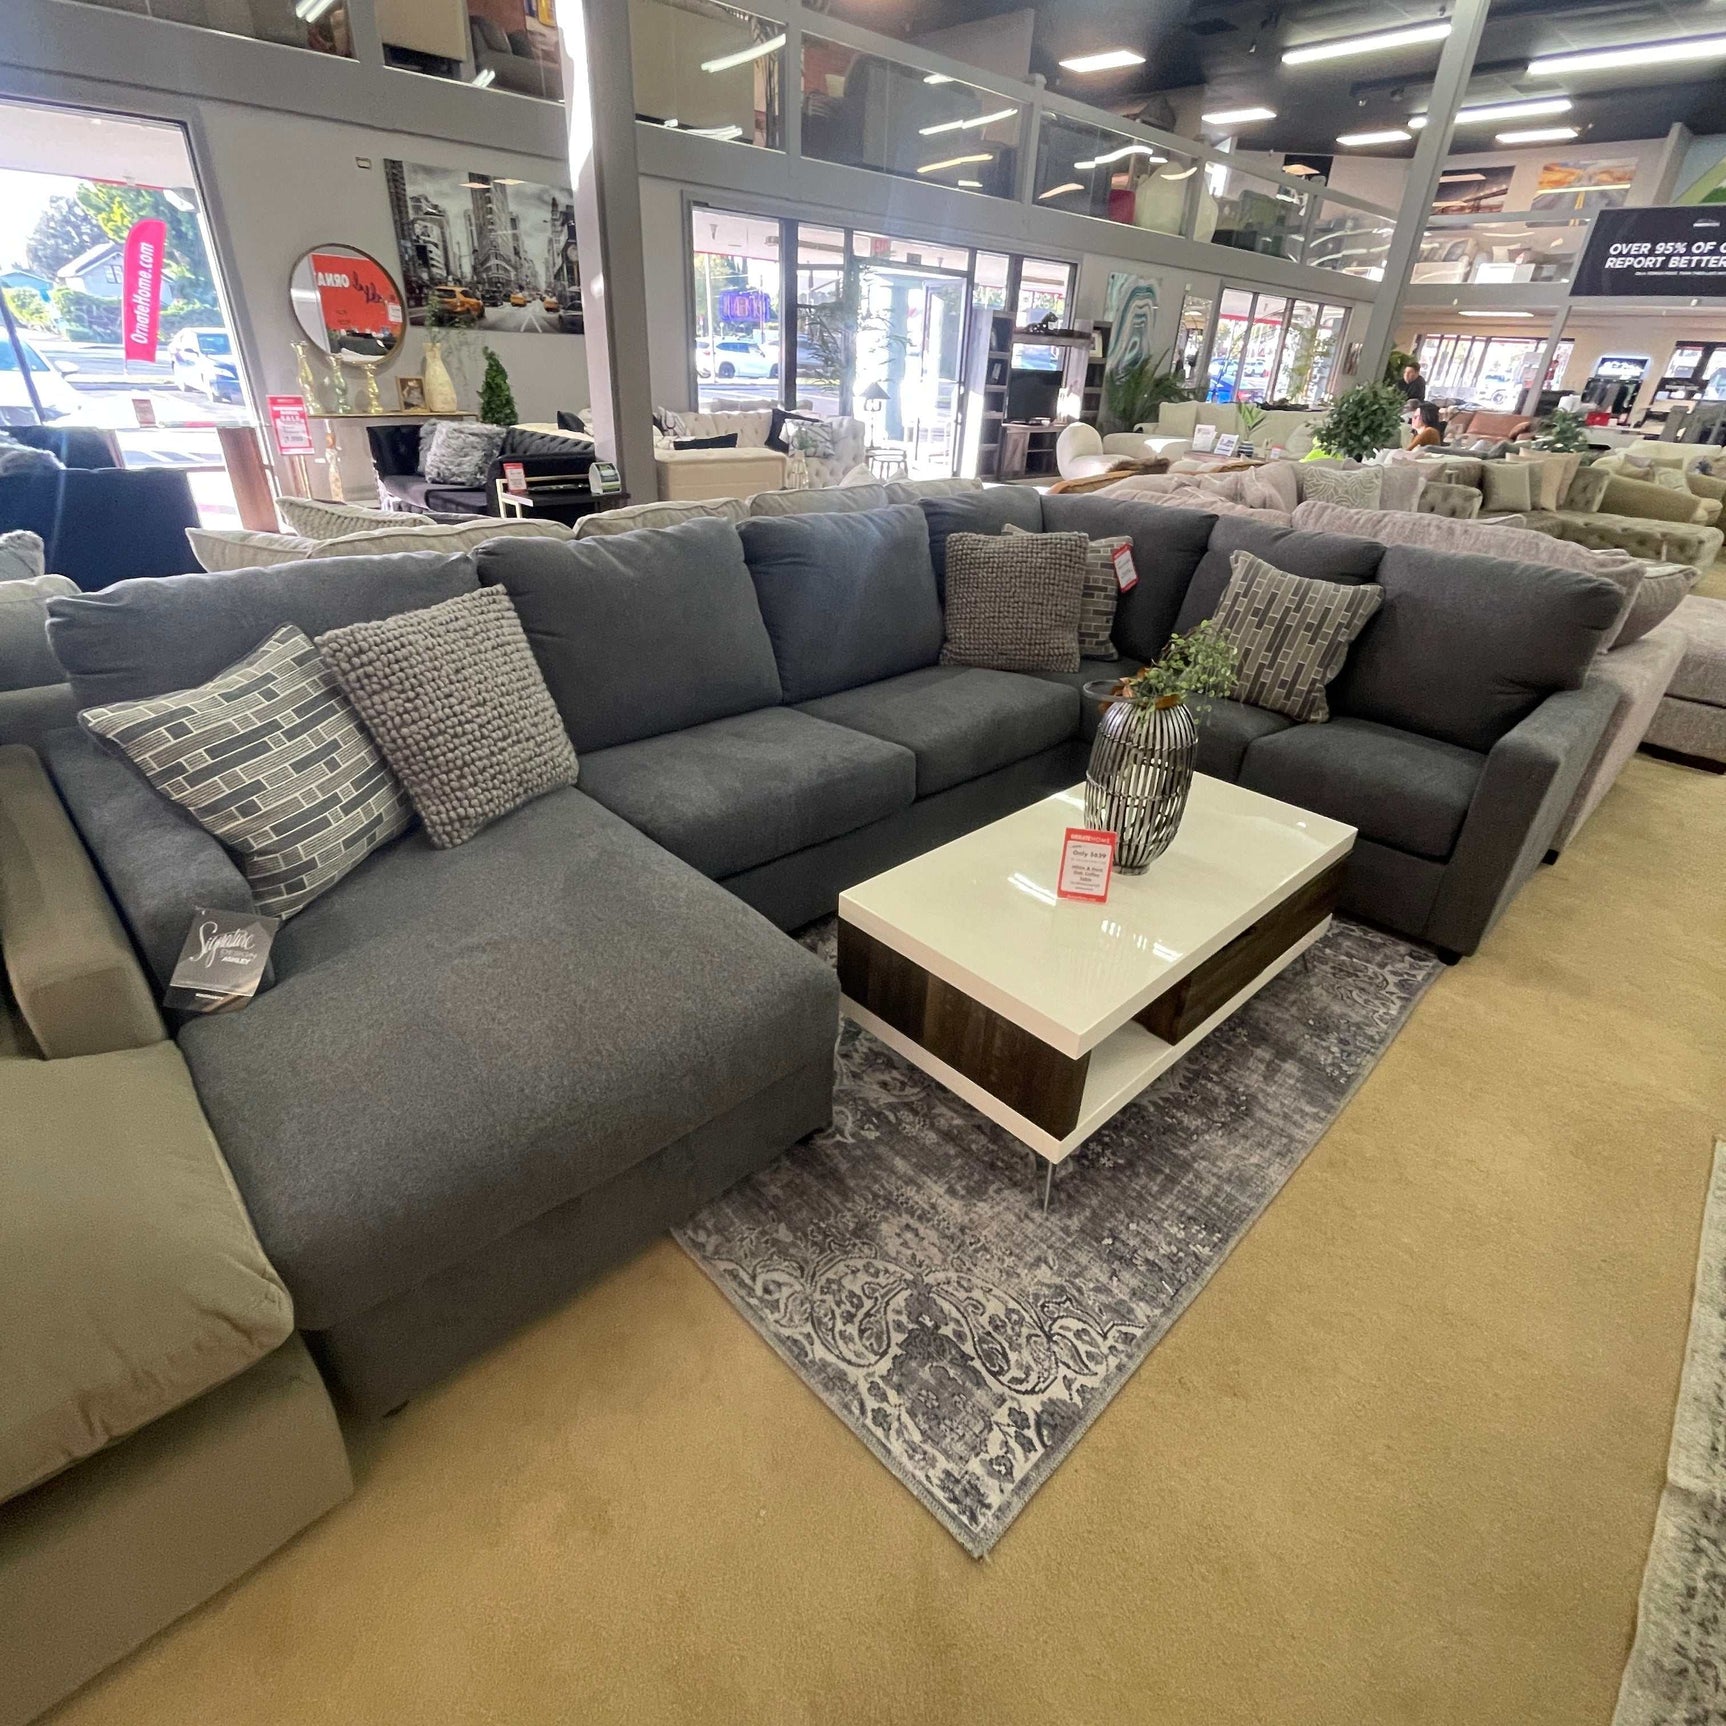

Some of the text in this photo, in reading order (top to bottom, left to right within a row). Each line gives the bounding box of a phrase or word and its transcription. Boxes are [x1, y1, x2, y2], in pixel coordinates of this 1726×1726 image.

[1604, 255, 1726, 269] REPORT BETTER
[1609, 242, 1652, 255] OVER
[1654, 242, 1687, 254] 95%
[1691, 241, 1717, 254] OF
[130, 241, 155, 344] OrnateHome.com
[189, 921, 256, 968] Signature
